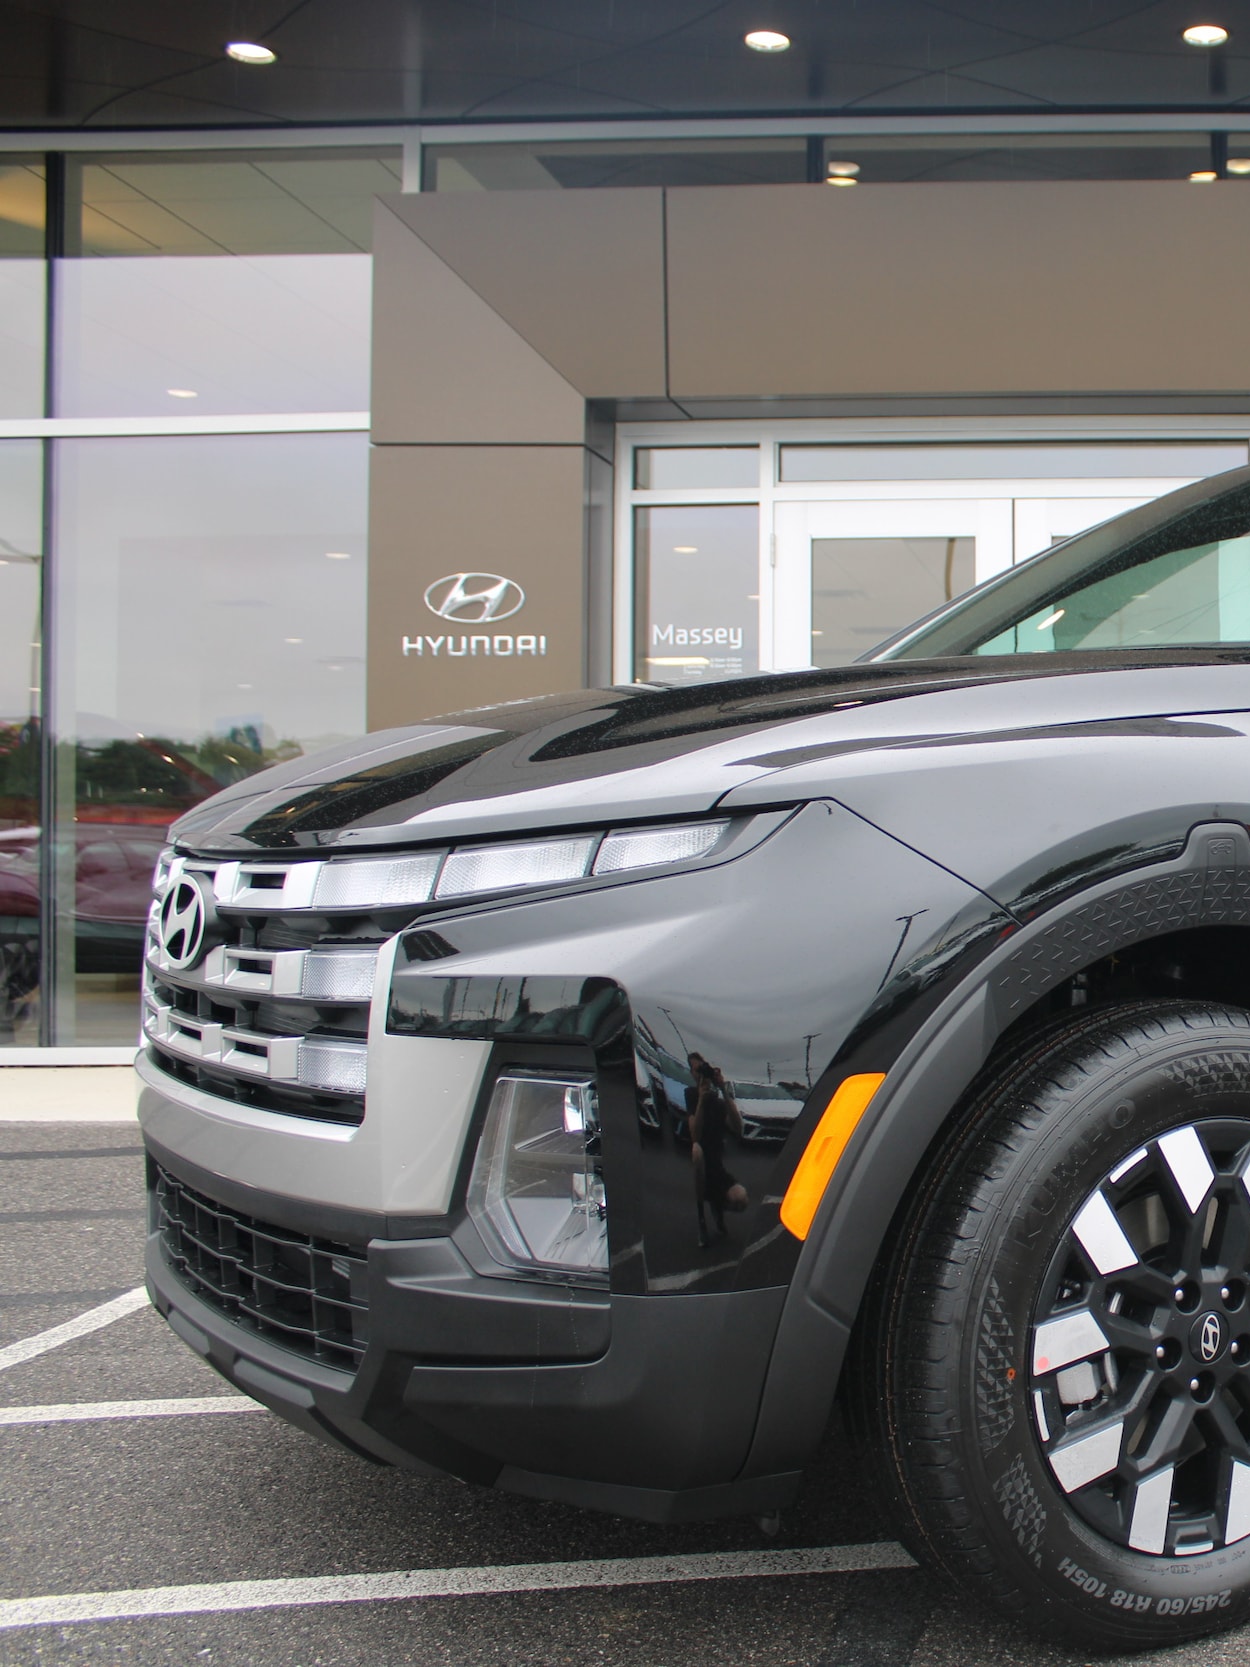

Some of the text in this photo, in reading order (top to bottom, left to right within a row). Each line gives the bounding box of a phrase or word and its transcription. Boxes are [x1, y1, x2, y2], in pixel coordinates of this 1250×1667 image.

[402, 634, 546, 657] HYUNDAI
[652, 623, 743, 649] Massey
[1057, 1557, 1232, 1616] 245/60 R18 105H
